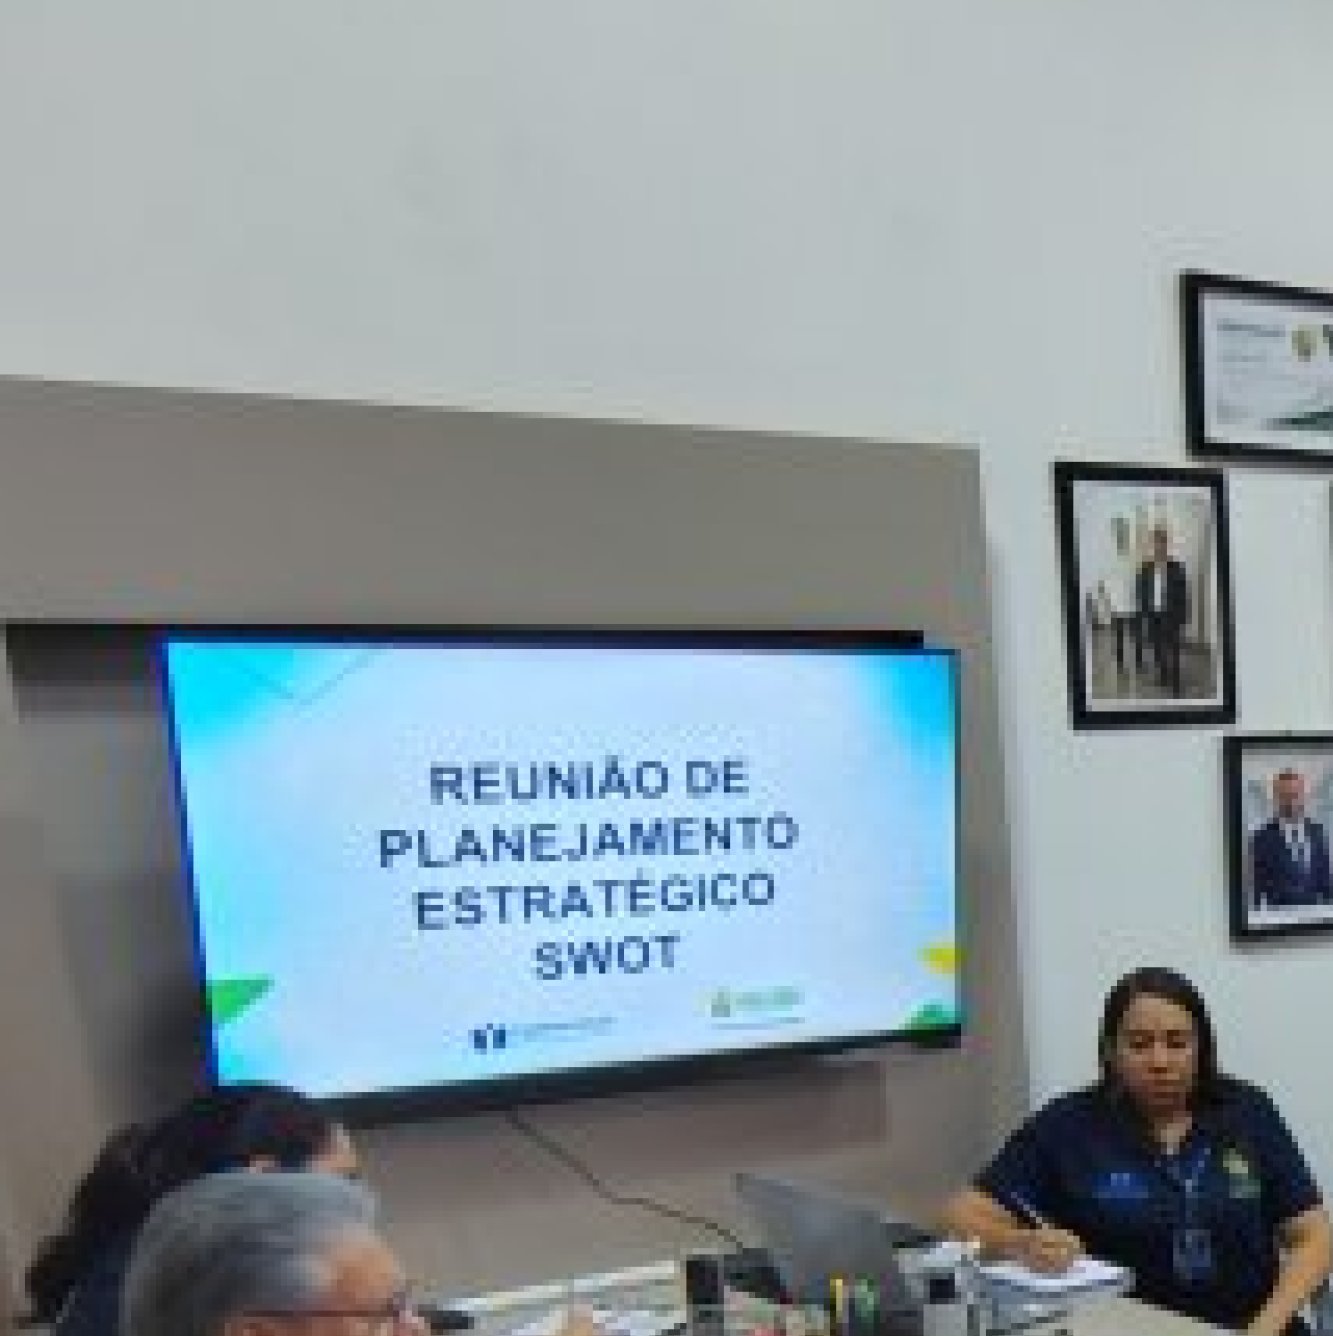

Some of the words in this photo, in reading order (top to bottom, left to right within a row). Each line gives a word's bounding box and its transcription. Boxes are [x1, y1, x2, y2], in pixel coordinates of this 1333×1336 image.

[429, 755, 669, 806] REUNIÃO
[685, 760, 750, 795] DE
[379, 811, 800, 870] PLANEJAMENTO
[415, 868, 775, 931] ESTRATÉGICO
[535, 934, 681, 981] SWOT
